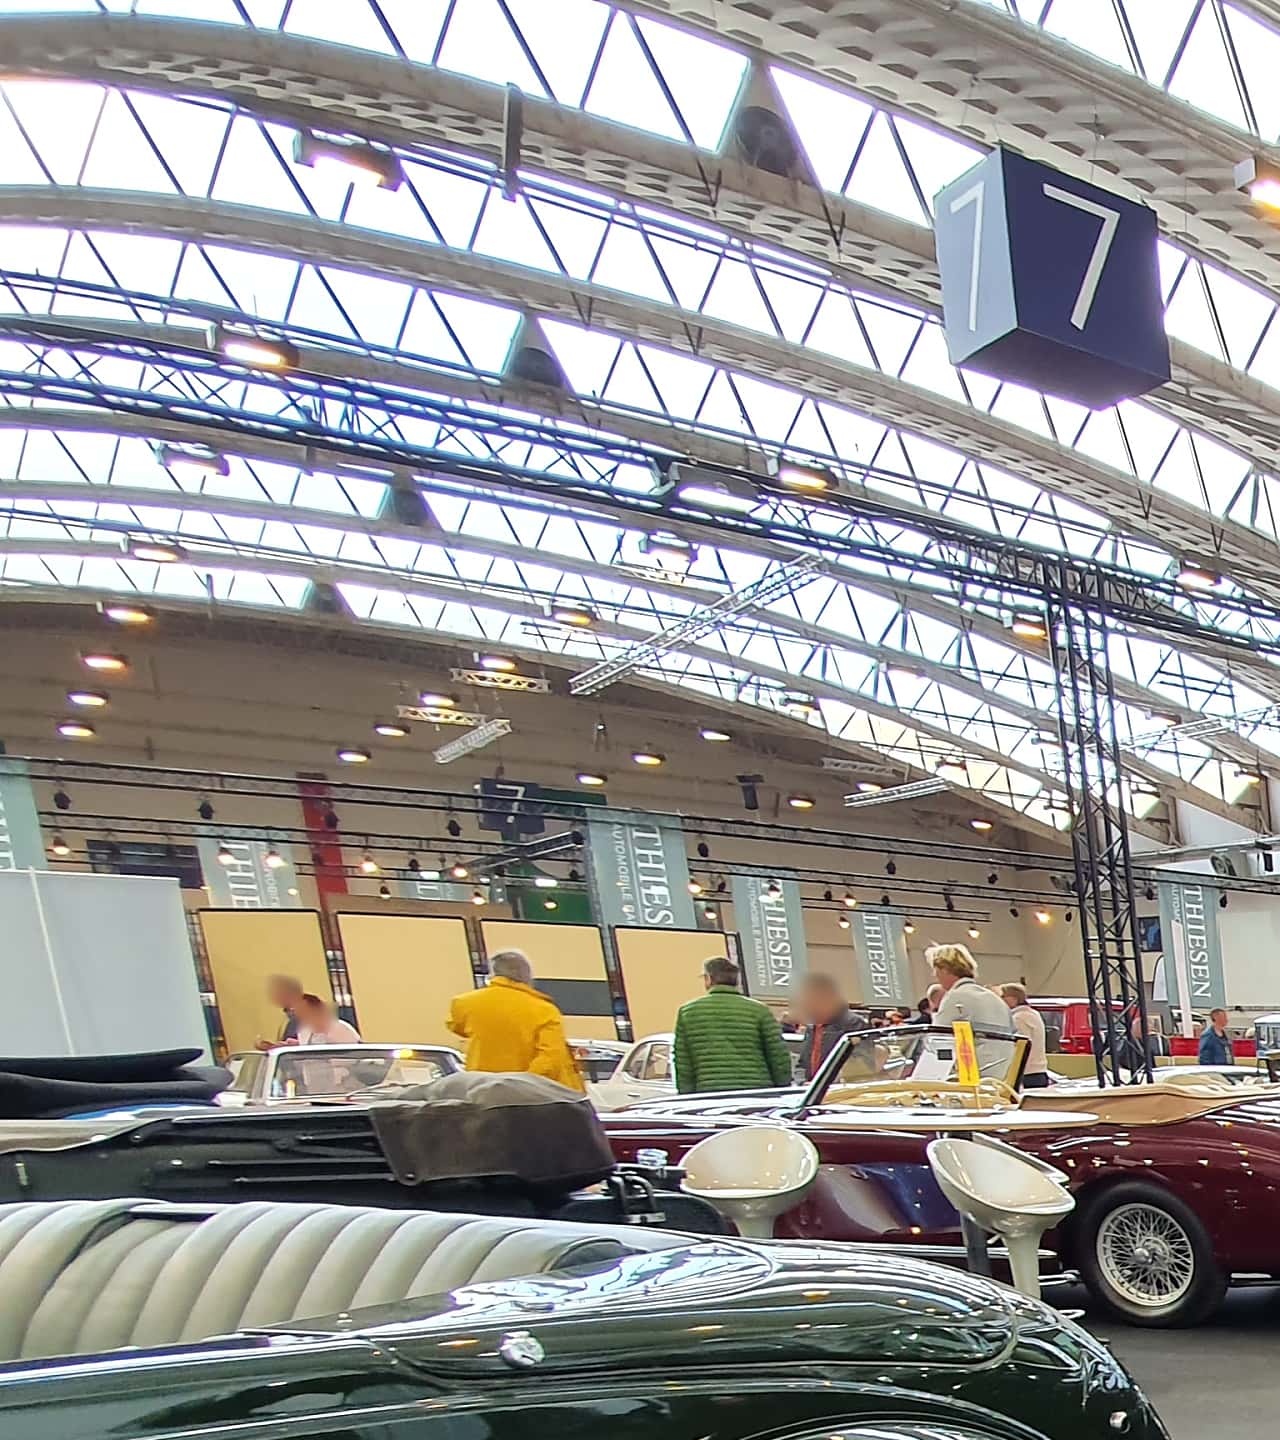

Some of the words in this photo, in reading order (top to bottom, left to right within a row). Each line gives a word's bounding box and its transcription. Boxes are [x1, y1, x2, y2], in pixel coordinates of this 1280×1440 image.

[1042, 183, 1121, 331] 7
[496, 784, 526, 824] 7
[1184, 885, 1212, 998] THIESEN
